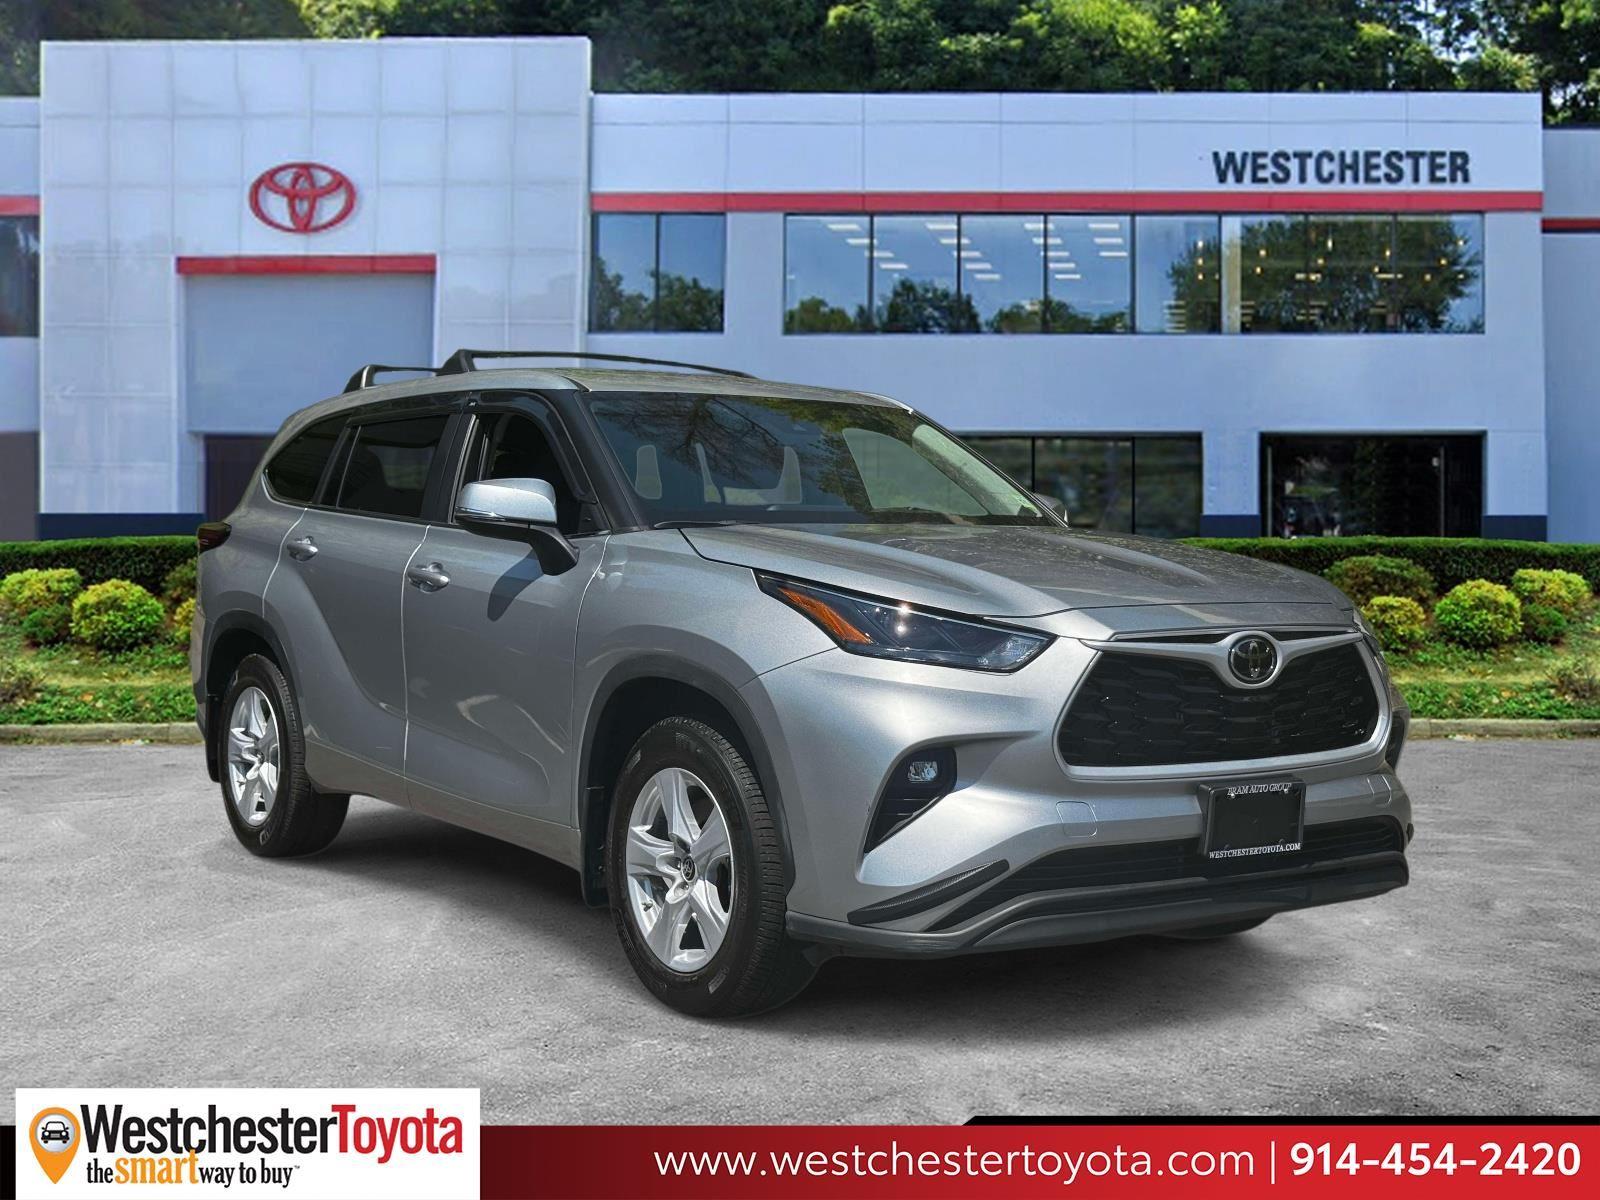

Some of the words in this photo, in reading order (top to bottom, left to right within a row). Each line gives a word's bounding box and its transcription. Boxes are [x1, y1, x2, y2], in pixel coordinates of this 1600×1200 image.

[1212, 150, 1471, 184] WESTCHESTER
[1249, 784, 1268, 793] AUTO
[1209, 842, 1301, 859] WESTCHESTERTOYOTA.COM
